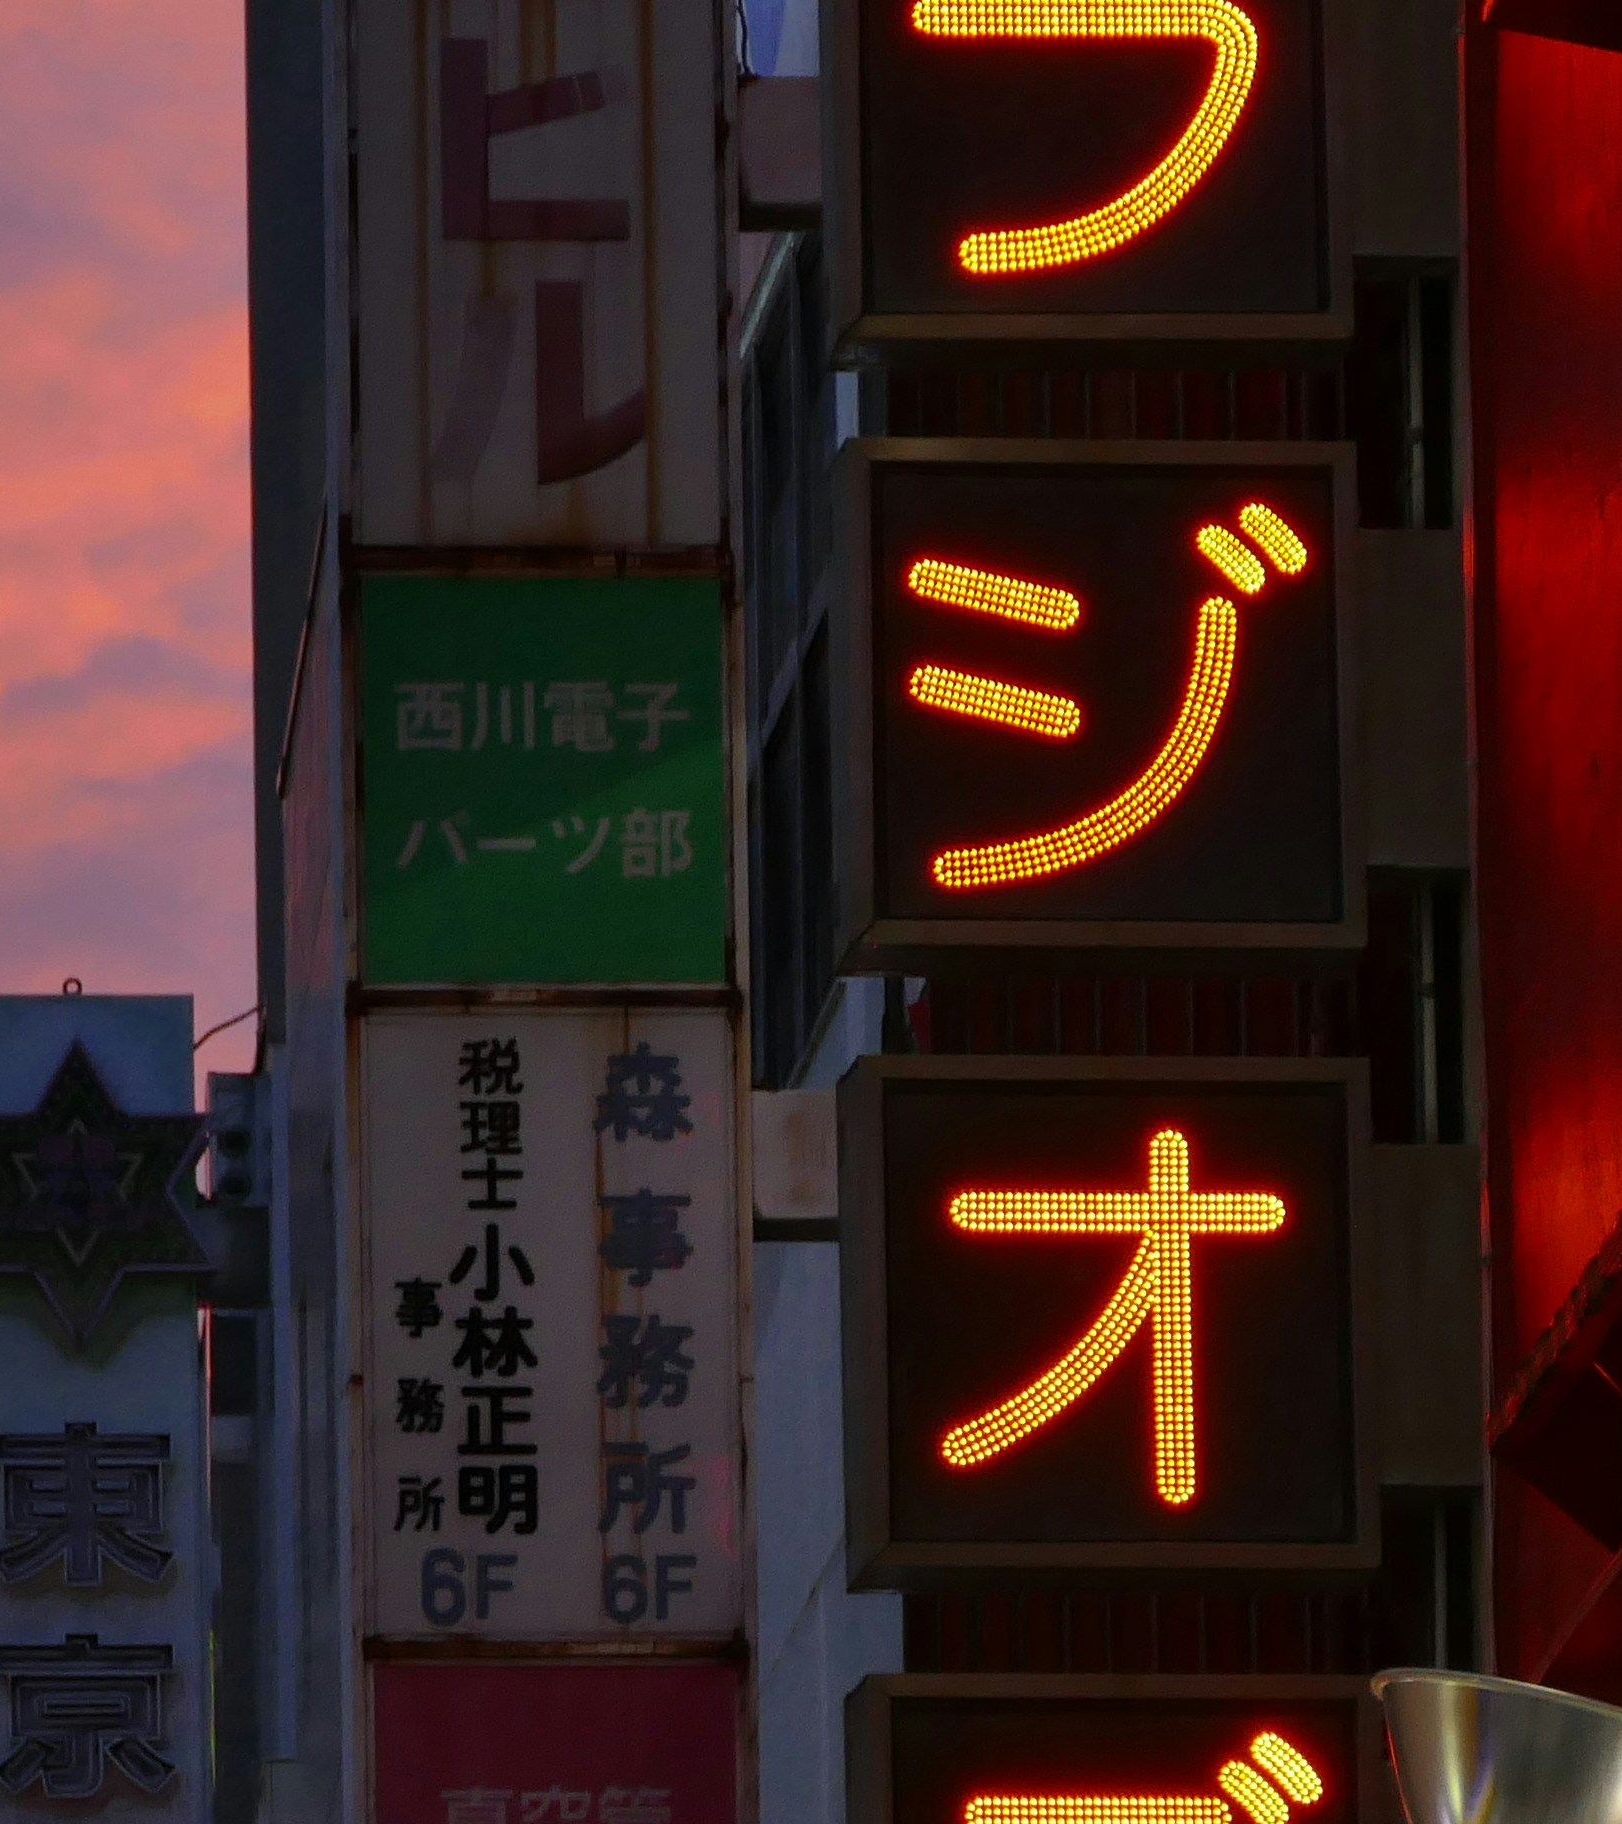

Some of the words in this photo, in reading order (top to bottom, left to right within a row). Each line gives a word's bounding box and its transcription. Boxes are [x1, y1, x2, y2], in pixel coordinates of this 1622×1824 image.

[393, 681, 689, 754] 西川電子
[396, 808, 693, 879] パーツ部
[449, 1037, 538, 1535] 税理士小林正明
[592, 1042, 695, 1535] 森事務所
[393, 1278, 446, 1532] 事務所
[420, 1547, 519, 1627] 6F
[601, 1554, 696, 1623] 6F
